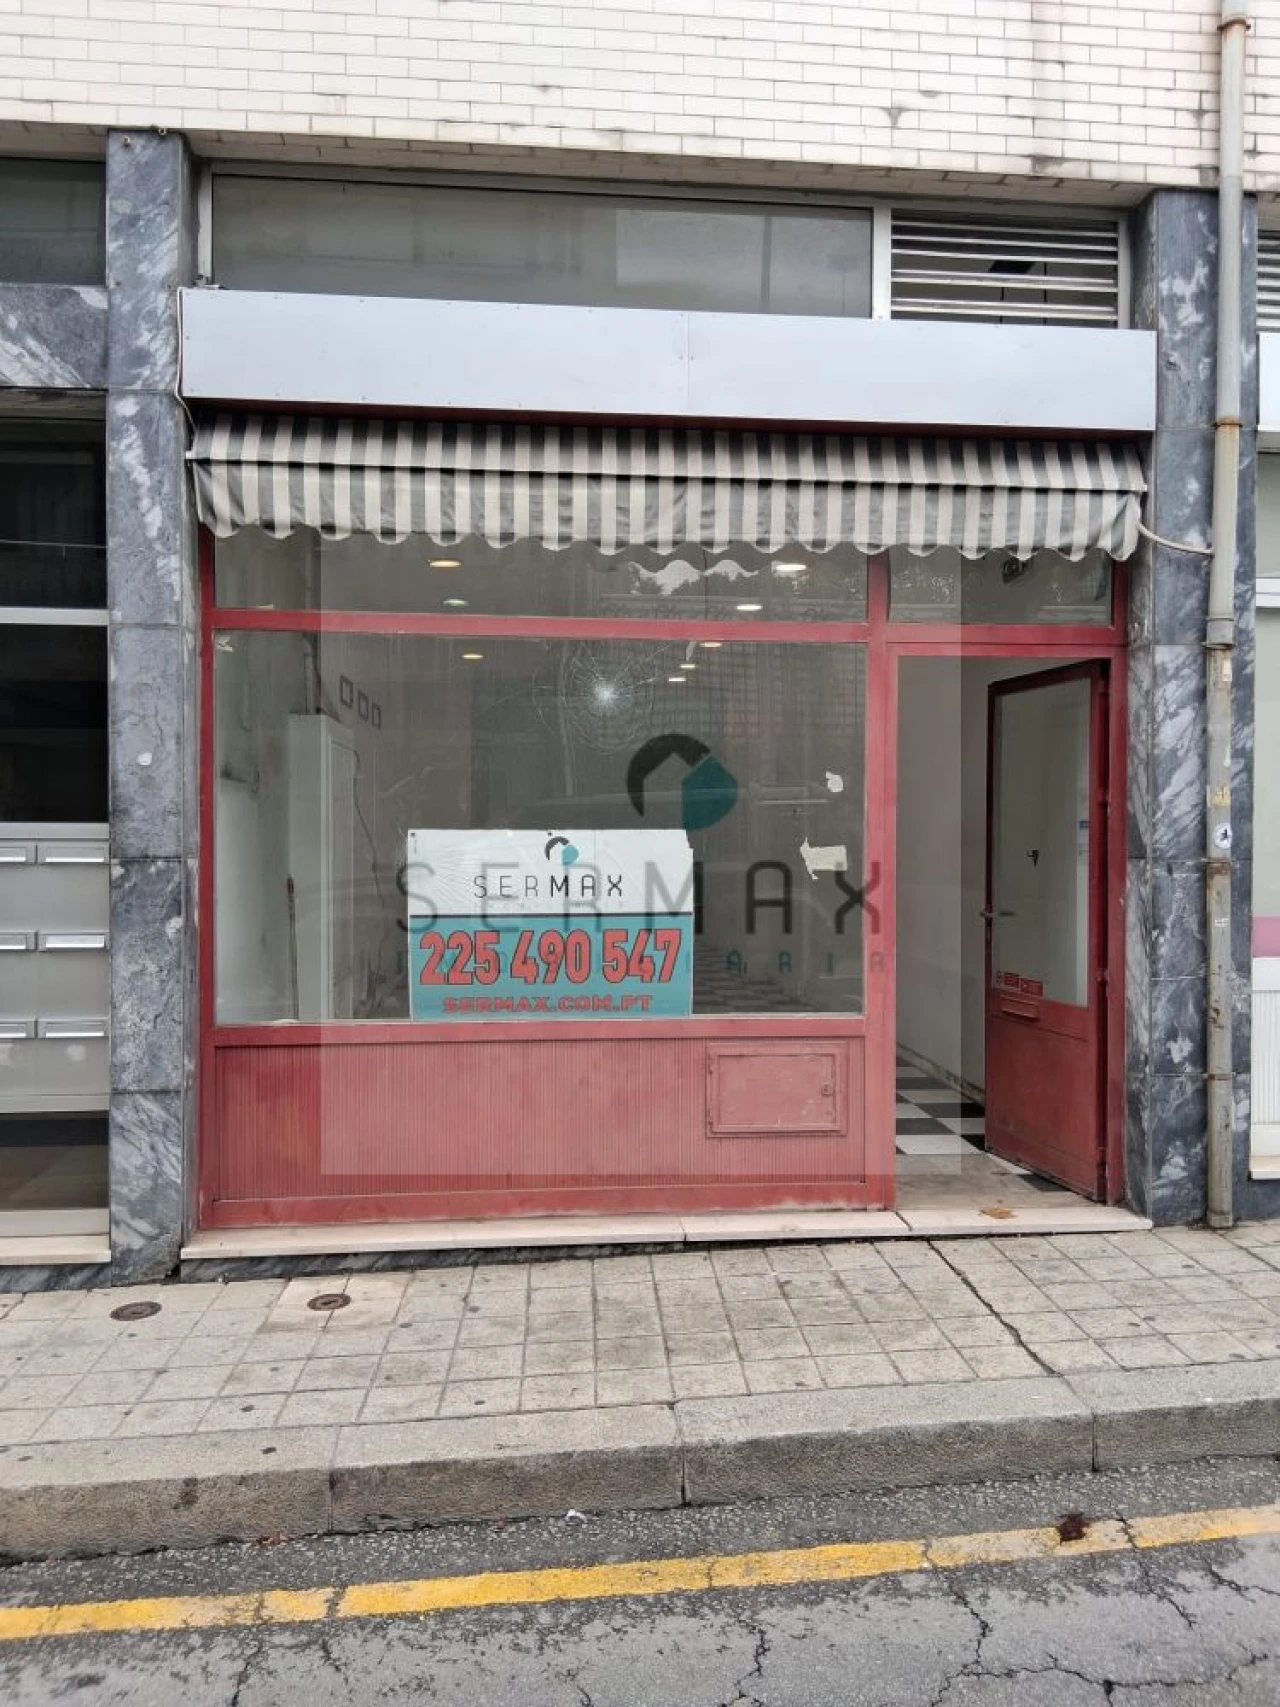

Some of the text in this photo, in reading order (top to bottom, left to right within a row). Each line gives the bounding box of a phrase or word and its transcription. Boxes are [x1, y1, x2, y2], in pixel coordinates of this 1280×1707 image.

[473, 875, 622, 898] SERMAX
[418, 929, 682, 985] 225 490 547
[443, 994, 654, 1014] SERMAX.COM.PT
